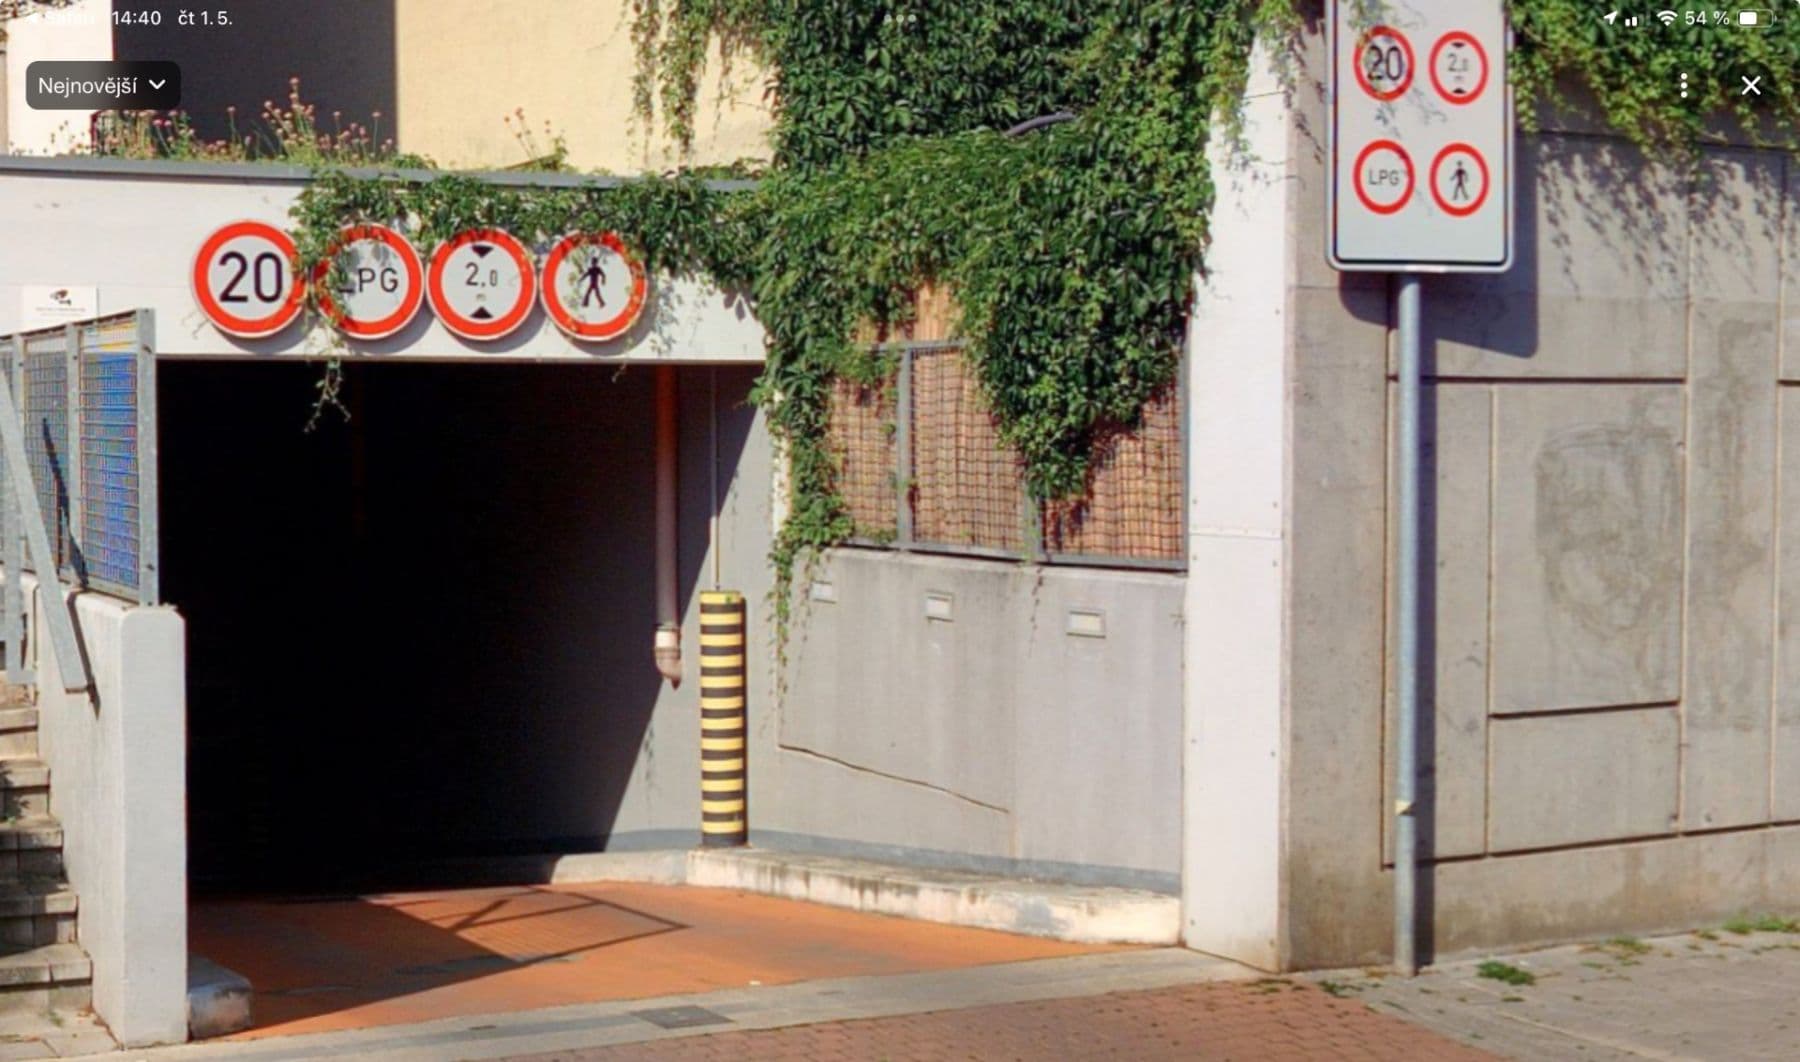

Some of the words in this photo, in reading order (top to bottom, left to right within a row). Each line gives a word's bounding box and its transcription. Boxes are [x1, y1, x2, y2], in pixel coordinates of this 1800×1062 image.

[1365, 44, 1403, 81] 20
[1368, 168, 1400, 187] LPG
[218, 251, 284, 303] 20
[465, 261, 498, 288] 2.0
